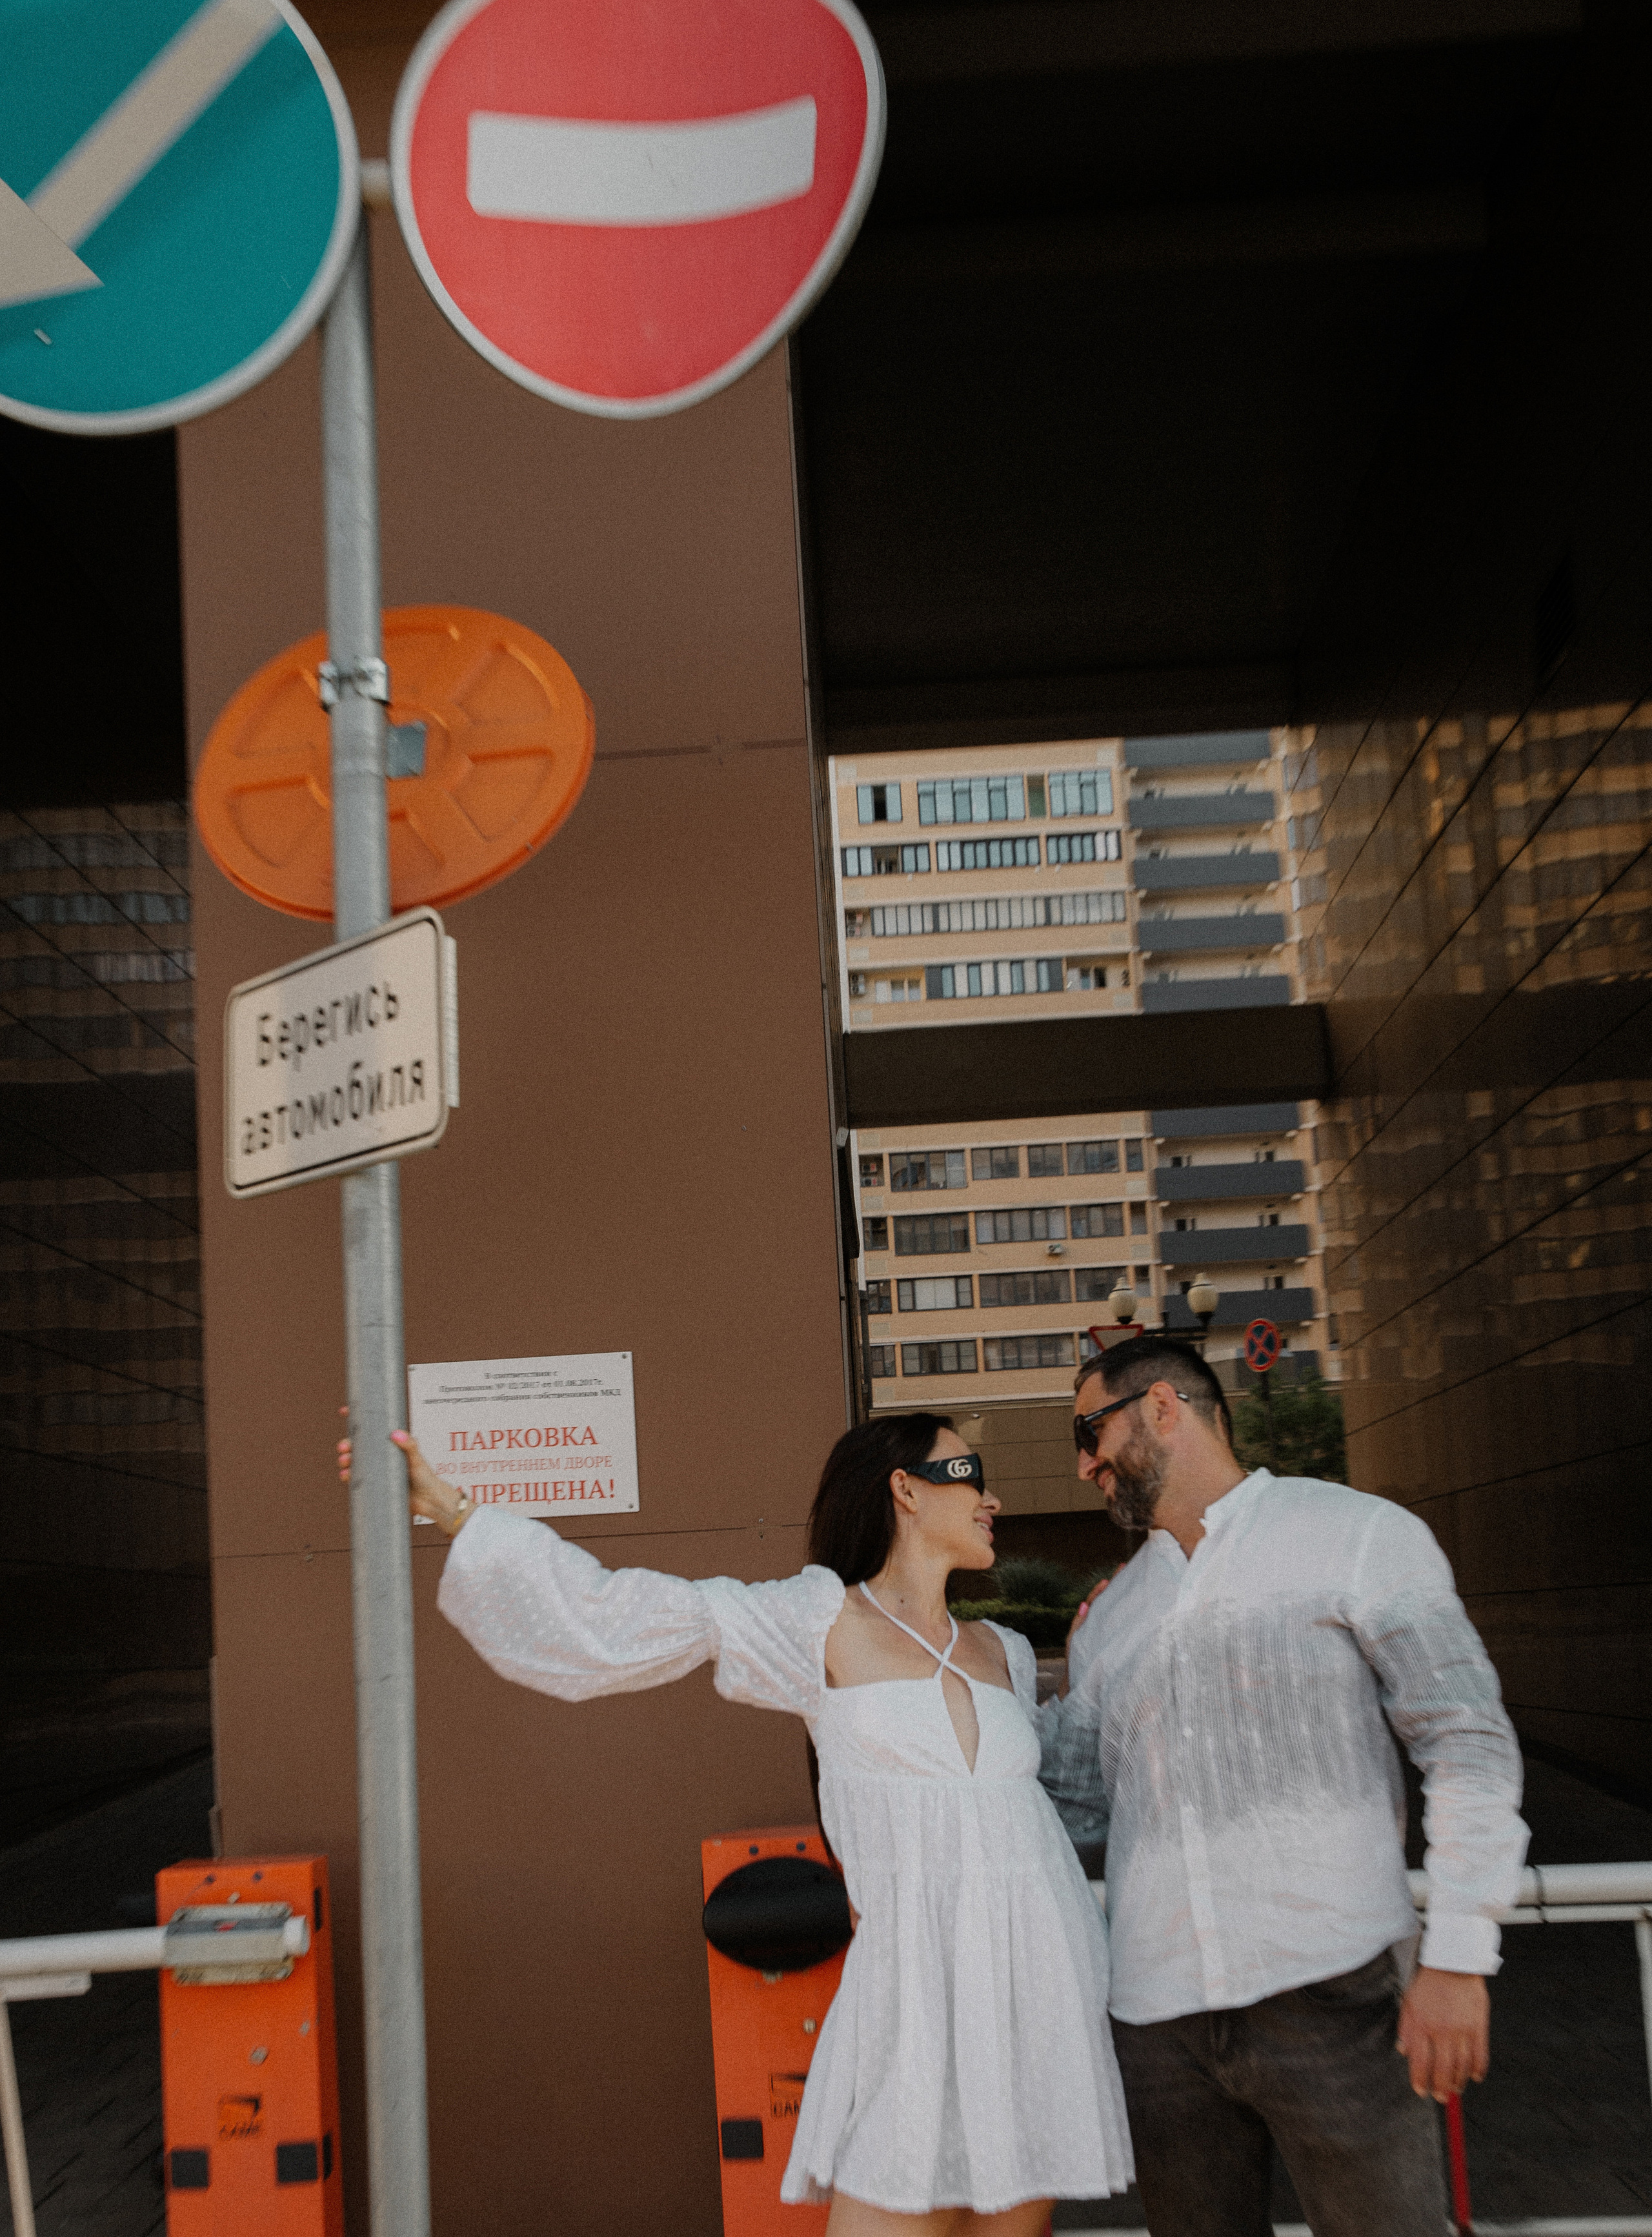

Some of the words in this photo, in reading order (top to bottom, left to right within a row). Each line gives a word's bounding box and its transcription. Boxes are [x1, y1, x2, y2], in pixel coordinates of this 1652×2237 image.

[257, 981, 399, 1073] Берегись
[243, 1060, 425, 1155] автомобиля
[449, 1425, 598, 1452] ПАРКОВКА
[461, 1457, 560, 1474] ВНУТРЕННЕМ
[564, 1455, 613, 1470] ДВОРЕ
[456, 1479, 616, 1504] ПРЕЩЕНА!
